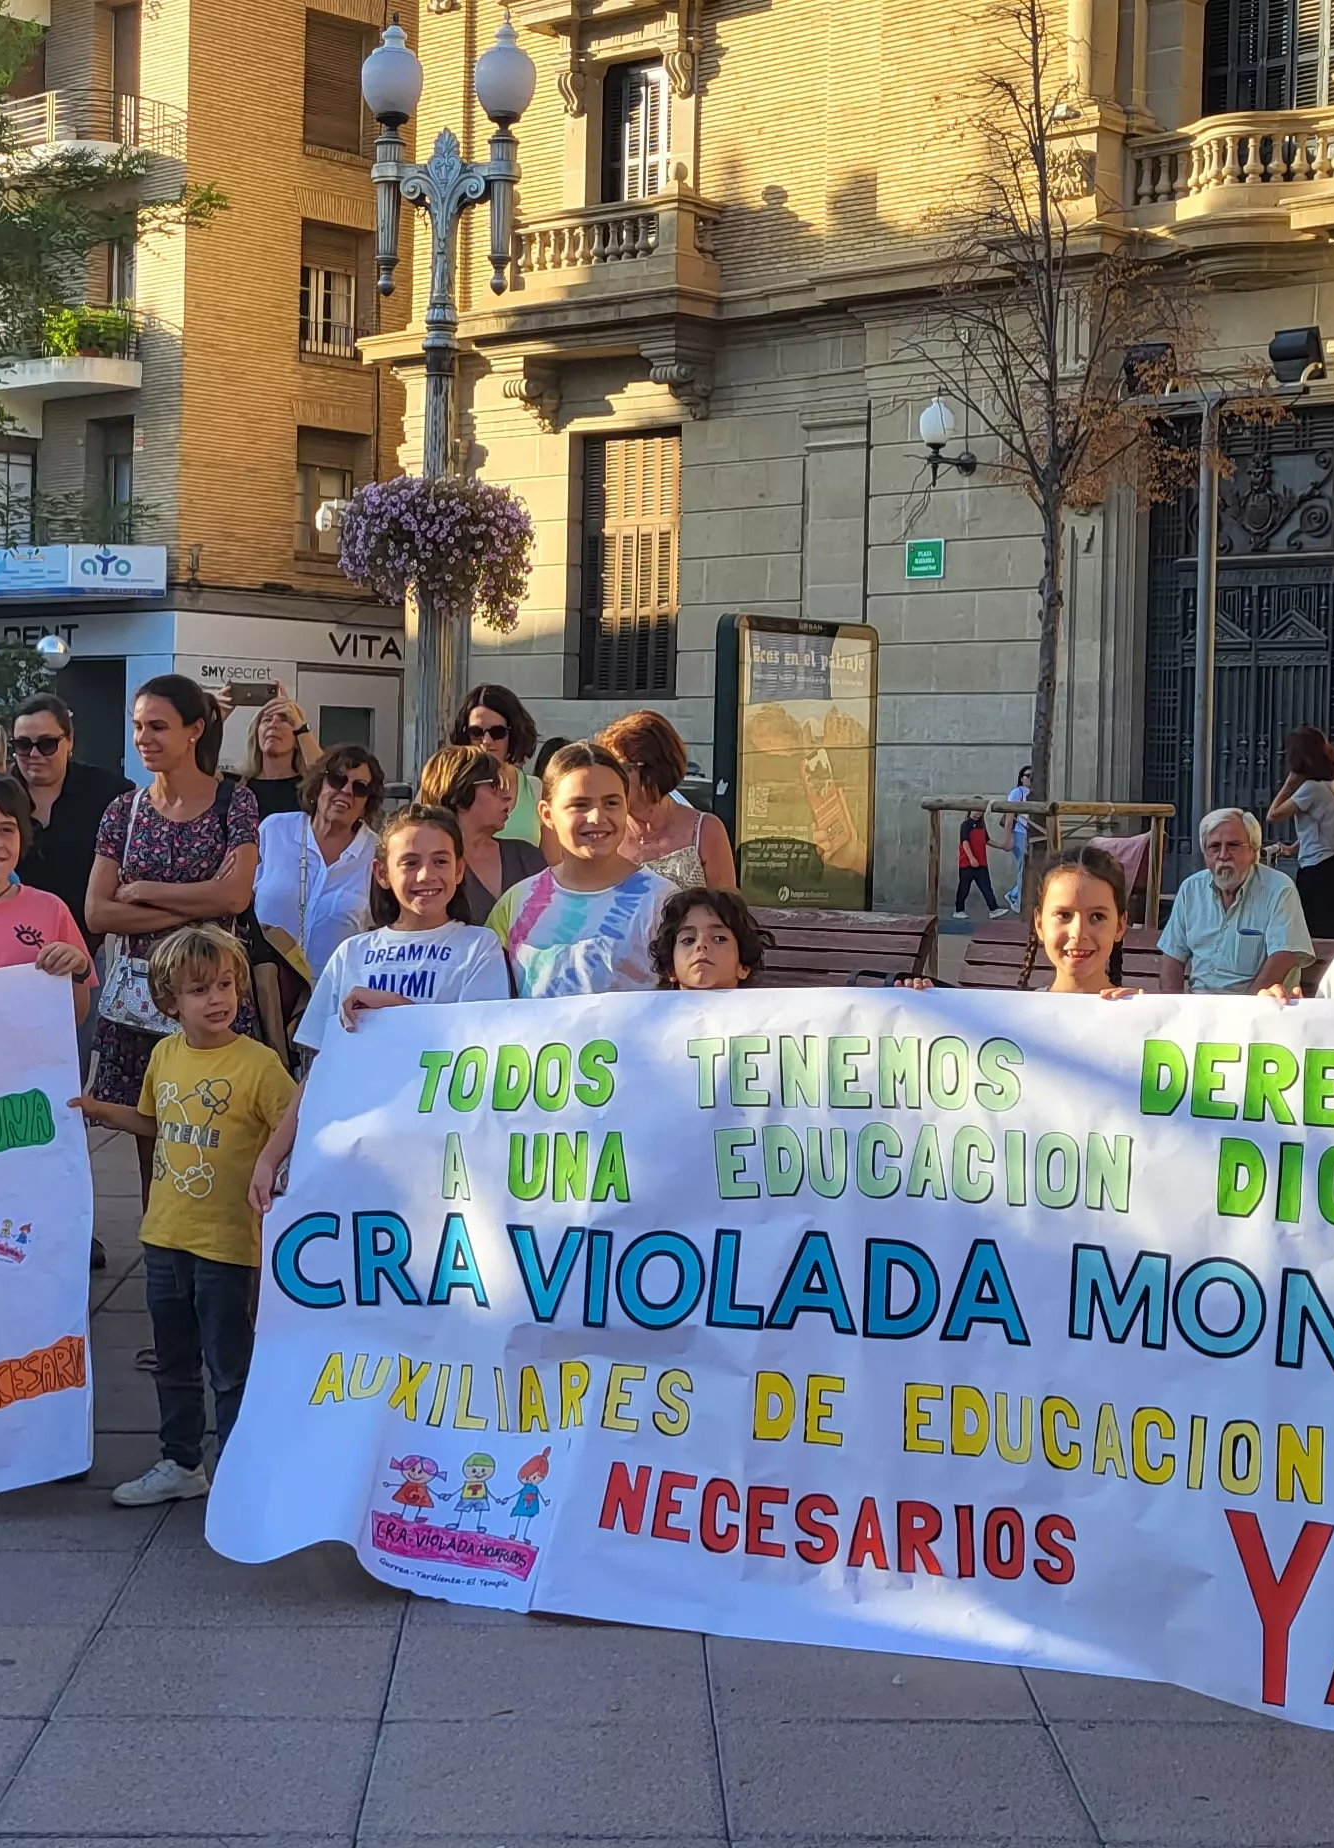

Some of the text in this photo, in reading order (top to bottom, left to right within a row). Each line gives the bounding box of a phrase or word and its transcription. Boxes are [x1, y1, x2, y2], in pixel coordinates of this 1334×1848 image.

[328, 631, 403, 660] VITA
[820, 652, 865, 673] paisaje
[417, 1038, 619, 1114] TODOS
[687, 1035, 1025, 1113] TENEMOS
[441, 1130, 472, 1201] A
[506, 1130, 631, 1203] UNA
[714, 1123, 1133, 1215] EDUCACION
[271, 1211, 491, 1310] CRA
[507, 1224, 1031, 1347] VIOLADA
[309, 1352, 693, 1438] AUXILIARES
[753, 1371, 846, 1448] DE
[903, 1383, 1324, 1507] EDUCACION
[598, 1461, 1078, 1586] NECESARIOS
[479, 1578, 509, 1590] Temple
